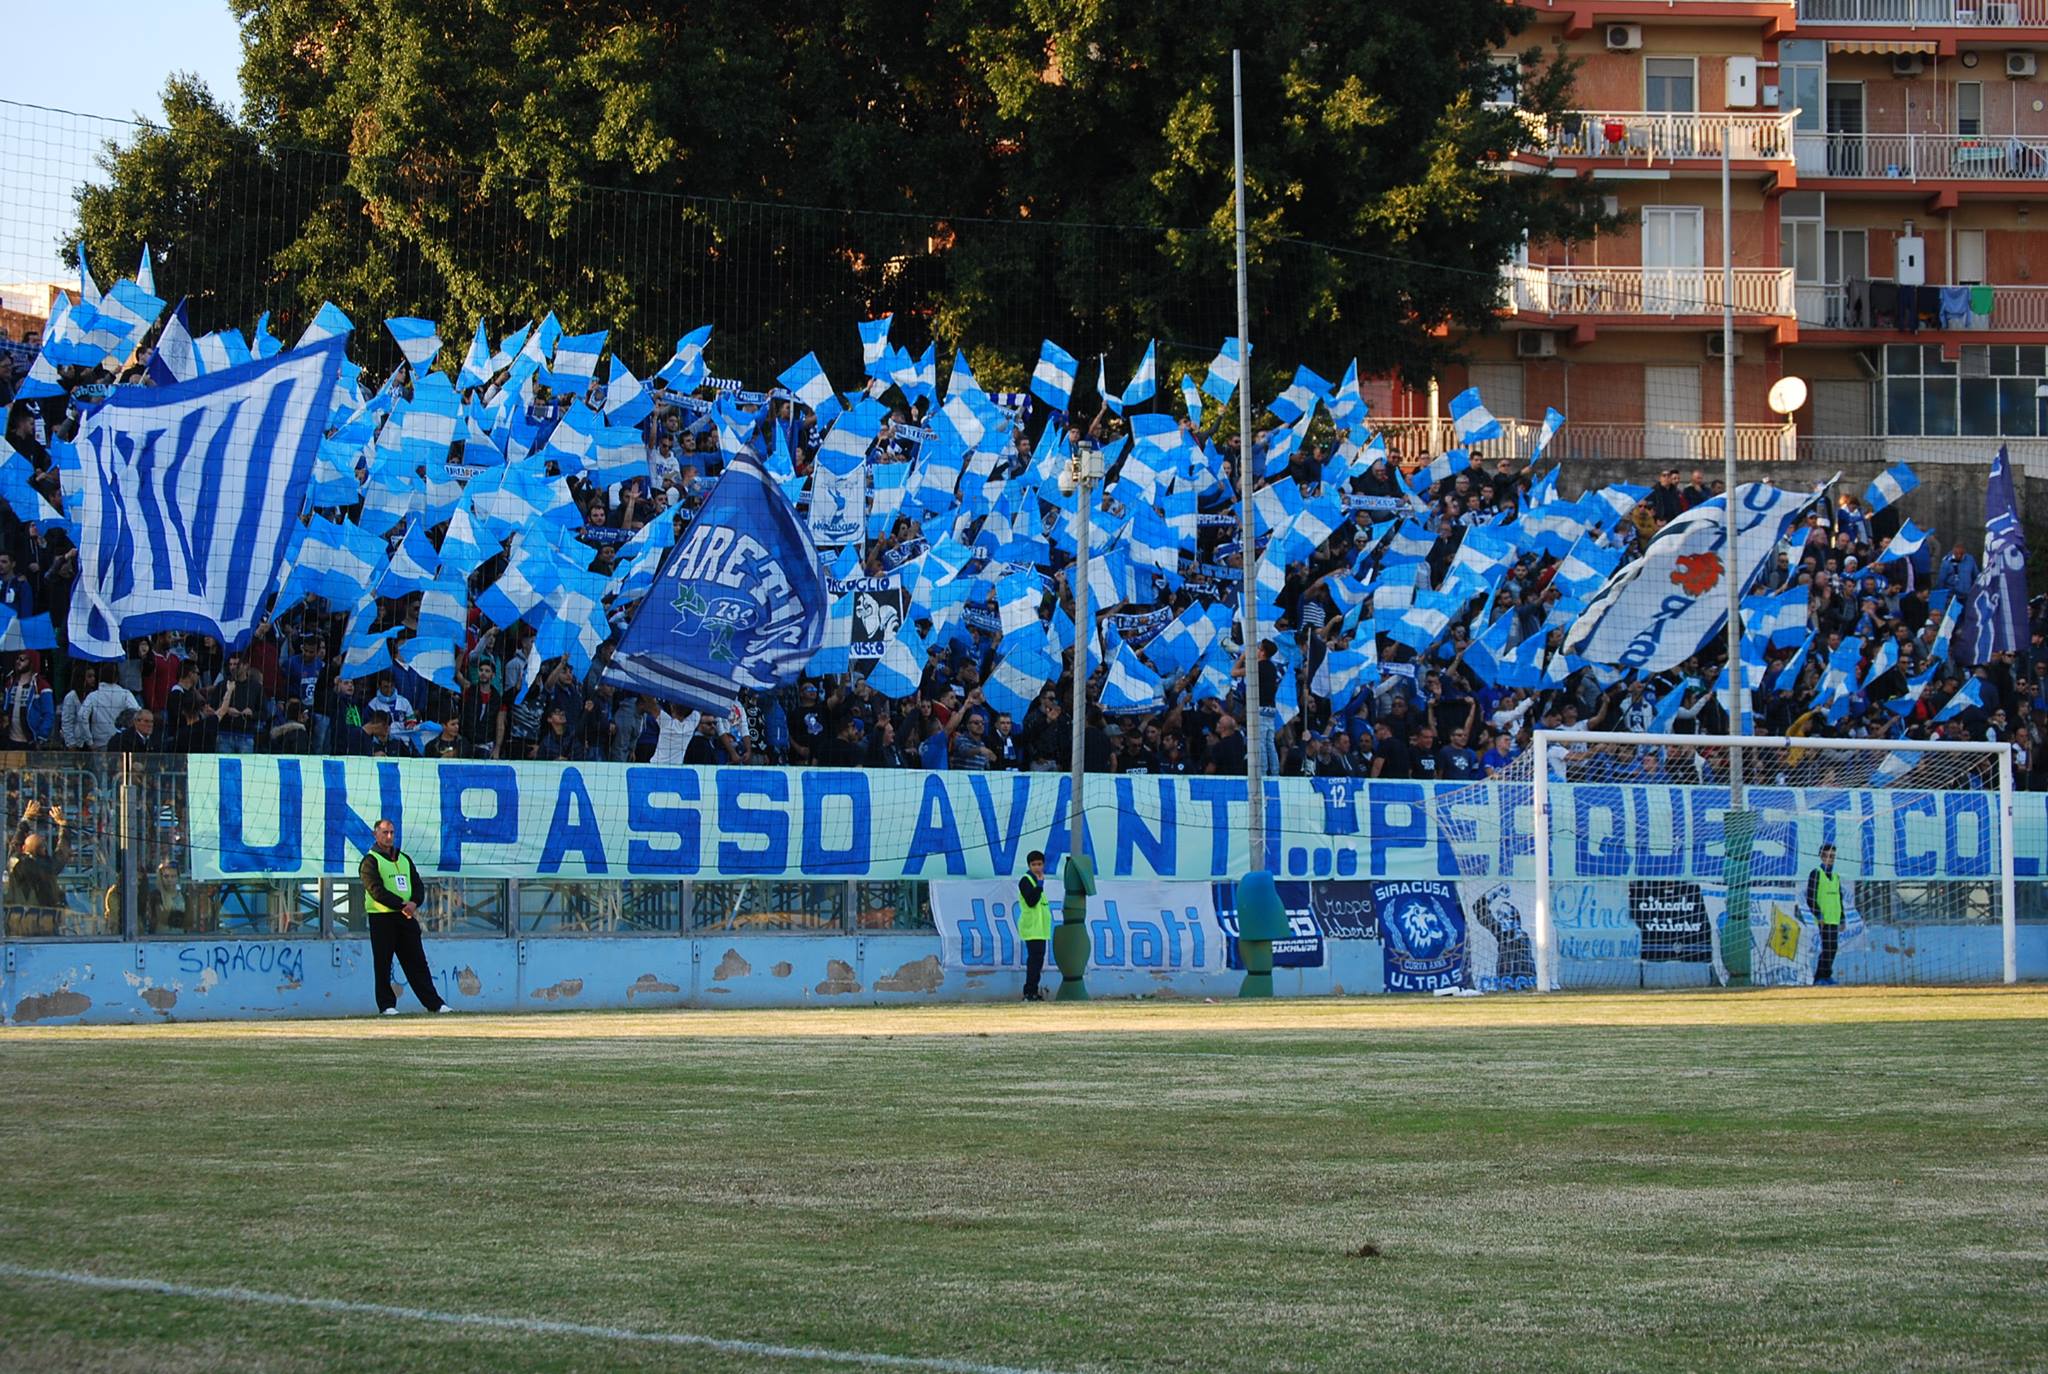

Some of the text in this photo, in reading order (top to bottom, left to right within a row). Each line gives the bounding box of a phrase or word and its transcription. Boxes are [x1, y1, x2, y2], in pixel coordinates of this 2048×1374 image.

[1330, 785, 1346, 809] 12
[218, 757, 402, 874] UN
[437, 763, 871, 876] PASSO
[1573, 786, 1874, 877] QUESTI
[1375, 881, 1450, 901] SIRACUSA
[1638, 896, 1696, 911] circolo
[1645, 917, 1702, 932] vizioso
[179, 944, 304, 981] SIRACUSA
[1391, 968, 1463, 990] ULTRAS
